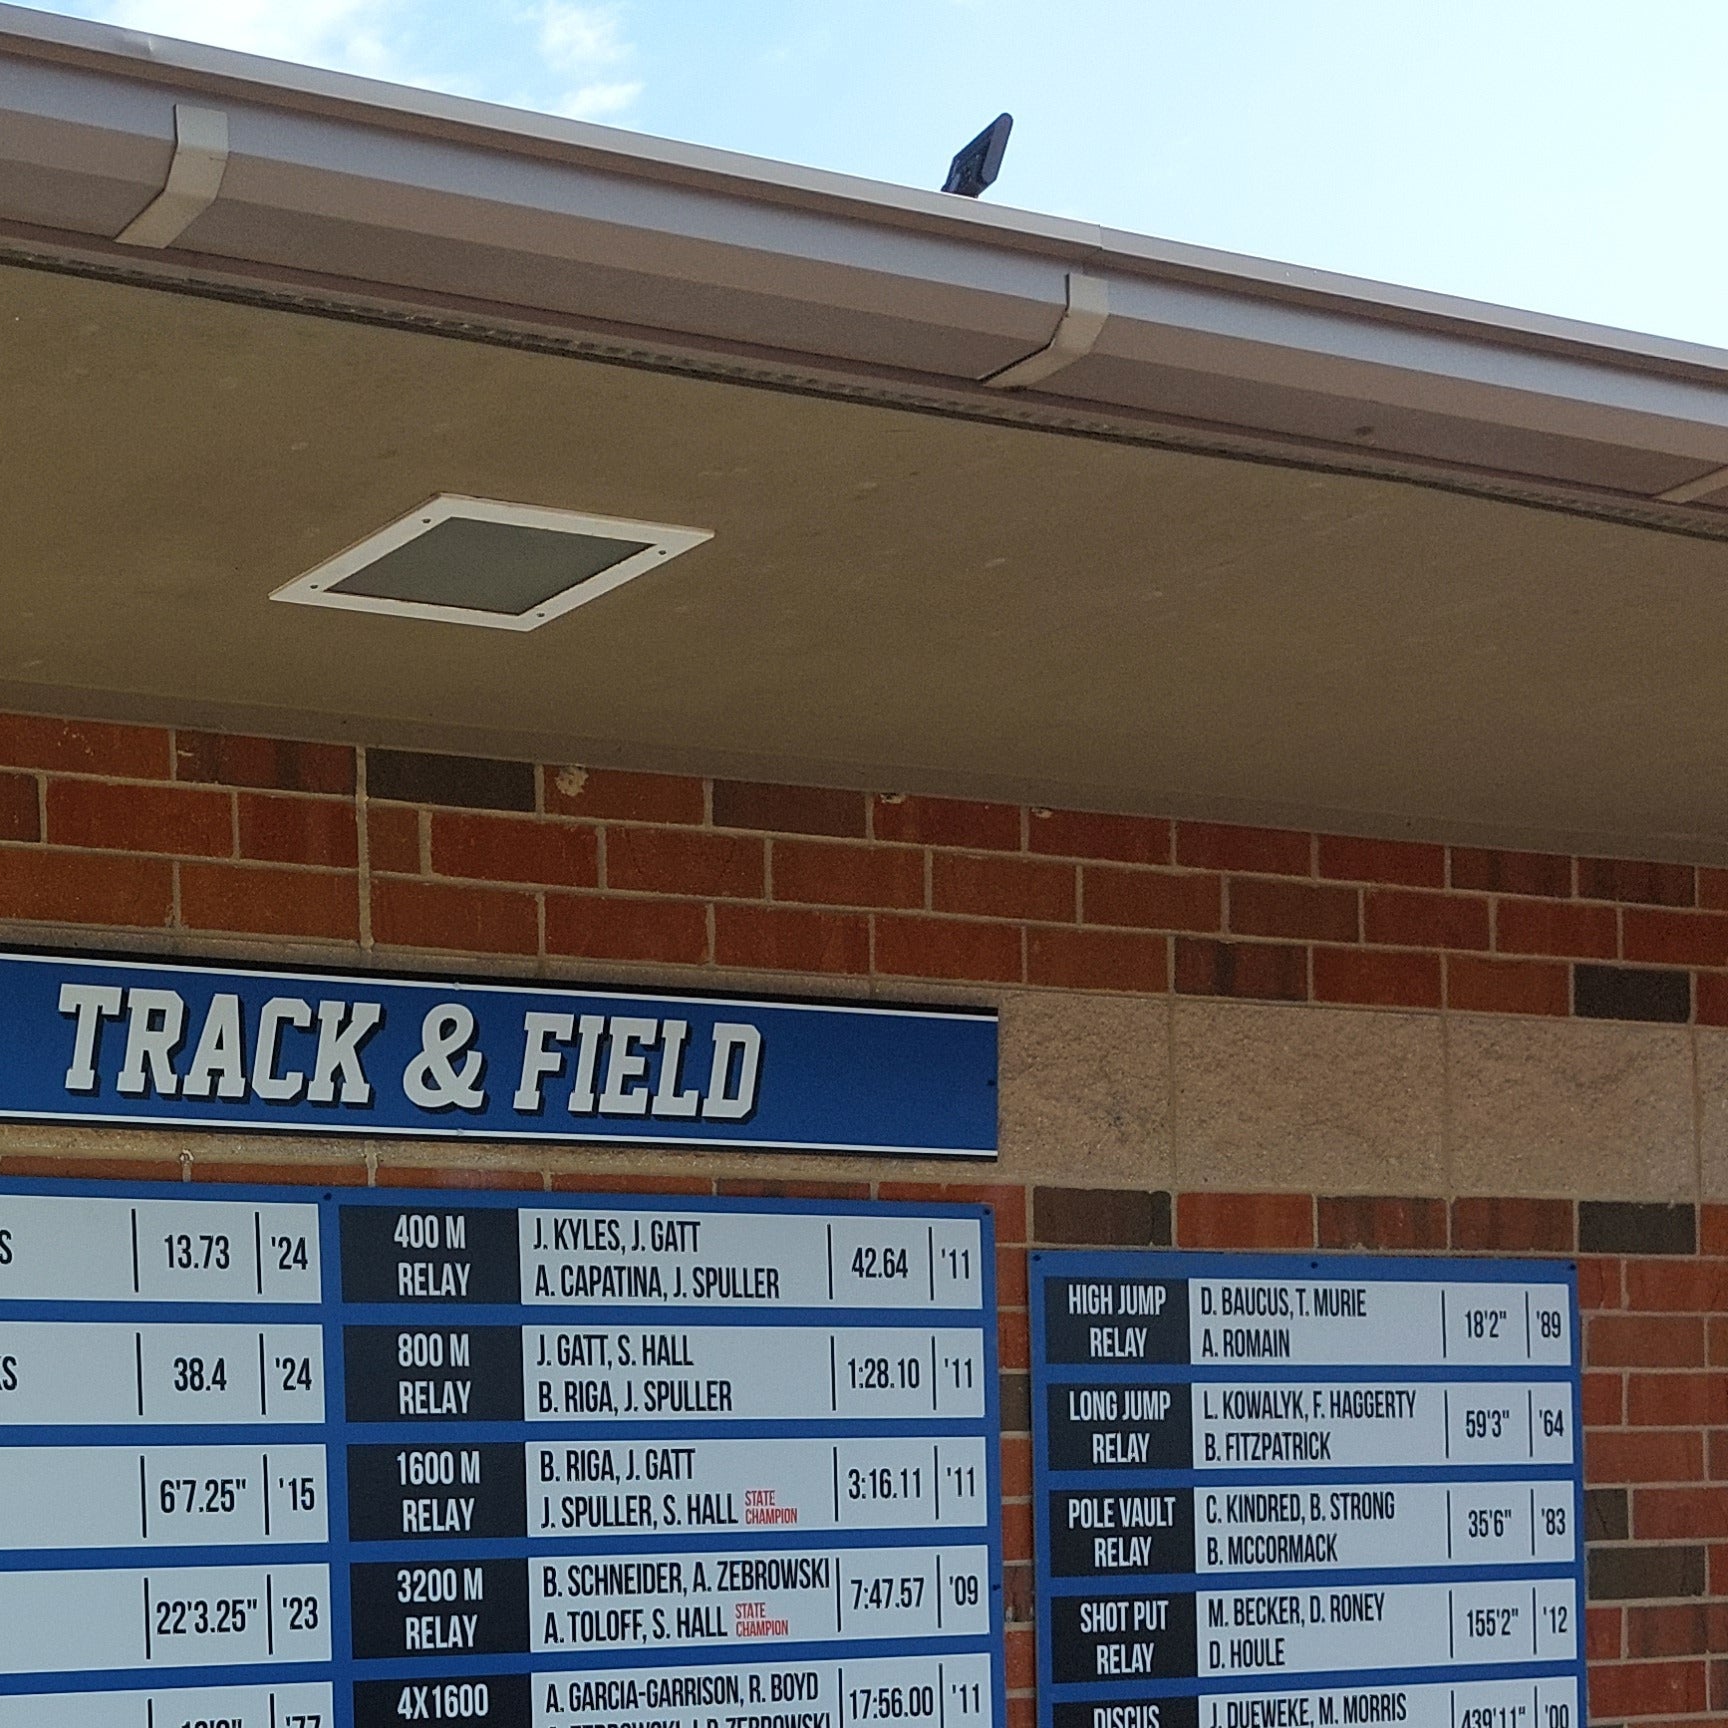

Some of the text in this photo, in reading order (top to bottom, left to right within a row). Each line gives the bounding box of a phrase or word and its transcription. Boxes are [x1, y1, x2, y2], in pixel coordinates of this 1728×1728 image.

[58, 983, 761, 1118] TRACK & FIELD
[394, 1215, 465, 1249] 400 M
[533, 1218, 701, 1255] J. KYLES, J. GATT
[164, 1234, 229, 1269] 13.73
[271, 1236, 308, 1270] '24
[852, 1247, 908, 1278] 42.64
[941, 1248, 969, 1279] '11
[398, 1262, 470, 1296] RELAY
[535, 1264, 779, 1302] A. CAPATINA, J. SPULLER
[1070, 1390, 1170, 1421] LONG JUMP
[1204, 1390, 1416, 1422] L. KOWALYK, F. HAGGERTY
[1466, 1410, 1509, 1438] 59'3"
[1539, 1409, 1564, 1437] '64
[1093, 1432, 1150, 1464] RELAY
[1205, 1431, 1331, 1461] B. FITZPATRICK
[1069, 1497, 1176, 1529] POLE VAULT
[1206, 1491, 1394, 1525] C. KINDRED, B. STRONG
[1468, 1509, 1511, 1538] 35'6"
[1541, 1508, 1565, 1535] '83
[1094, 1536, 1152, 1567] RELAY
[1207, 1533, 1338, 1565] B. MCCORMACK
[397, 1568, 483, 1603] 3200 M
[543, 1558, 829, 1597] B. SCHNEIDER, A. ZEBROWSKI
[851, 1577, 924, 1610] 7:47.57
[949, 1575, 978, 1606] '09
[157, 1599, 257, 1635] 22'3.25"
[283, 1596, 318, 1630] '23
[544, 1606, 728, 1644] A. TOLOFF, S. HALL
[735, 1602, 766, 1619] STATE
[1080, 1600, 1169, 1633] SHOT PUT
[1208, 1592, 1385, 1627] M. BECKER, D. RONEY
[1467, 1608, 1518, 1637] 155'2"
[1543, 1606, 1567, 1634] '12
[406, 1614, 477, 1649] RELAY
[736, 1620, 788, 1637] CHAMPION
[1097, 1643, 1154, 1675] RELAY
[1209, 1638, 1285, 1669] D. HOULE
[397, 1684, 488, 1719] 4X1600
[546, 1672, 818, 1713] A. GARCIA-GARRISON, R. BOYD
[849, 1686, 933, 1720] 17:56.00
[952, 1683, 979, 1714] '11
[1319, 1697, 1338, 1725] M.
[1343, 1693, 1406, 1724] MORRIS
